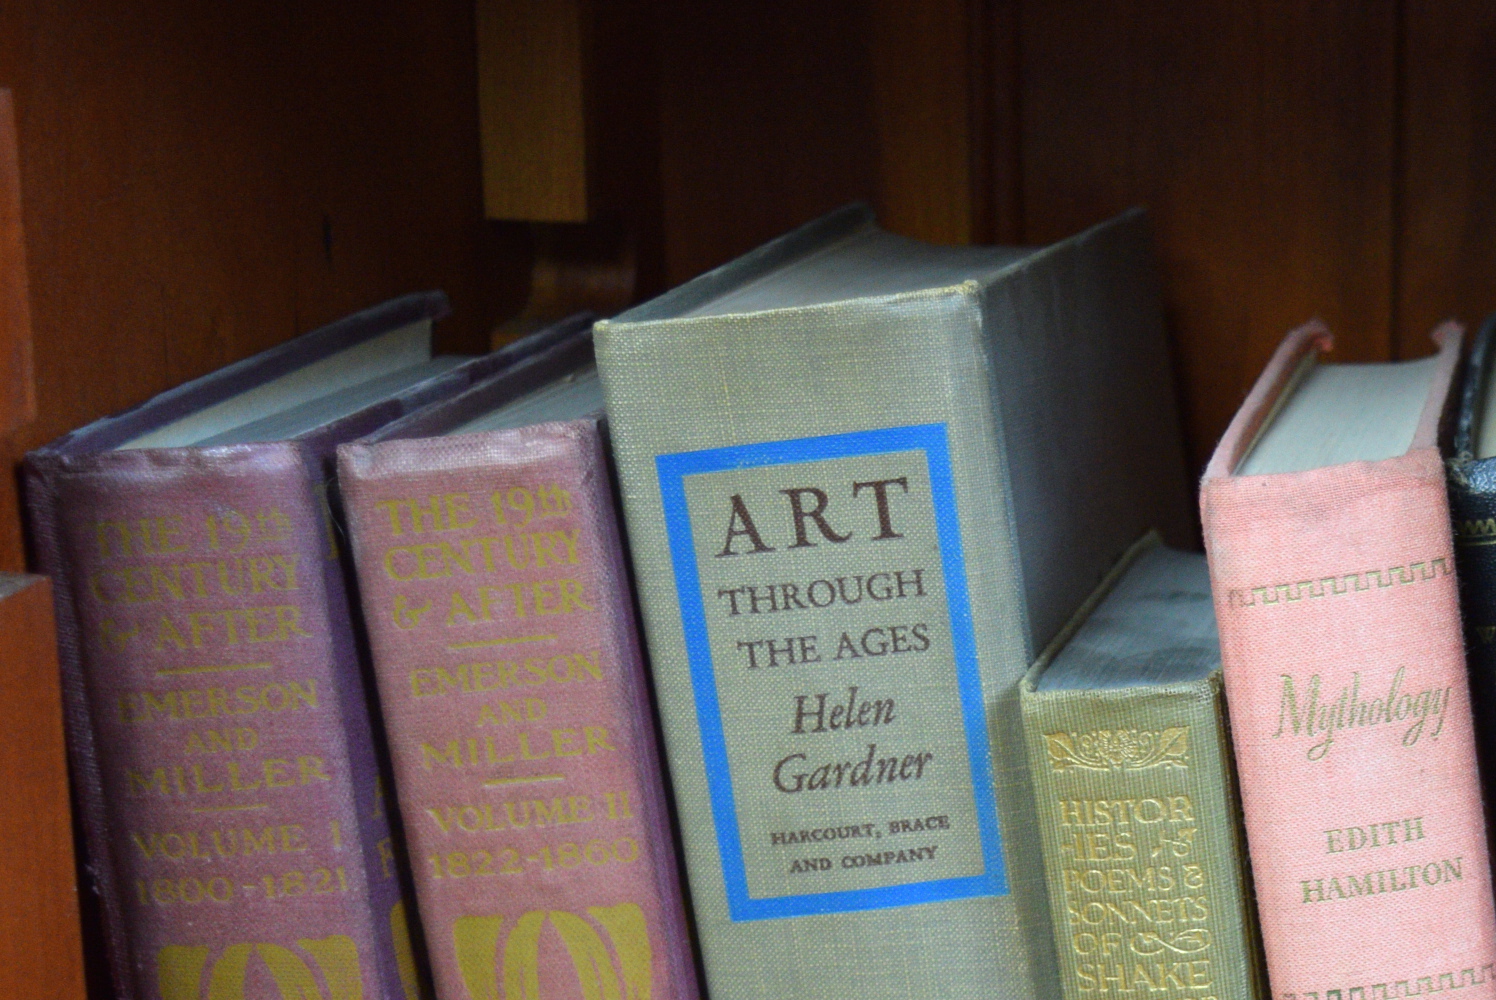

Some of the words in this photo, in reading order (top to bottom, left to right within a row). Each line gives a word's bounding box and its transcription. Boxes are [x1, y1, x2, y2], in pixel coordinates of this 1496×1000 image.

[86, 514, 189, 557] THE
[205, 505, 293, 554] 19th
[374, 491, 479, 536] THE
[490, 482, 573, 528] 19th
[714, 476, 910, 560] ART
[383, 528, 582, 581] CENTURY
[91, 554, 301, 603] CENTURY
[717, 568, 928, 617] THROUGH
[392, 594, 433, 629] &
[446, 578, 595, 626] AFTER
[99, 616, 141, 651] &
[156, 604, 313, 651] AFTER
[737, 634, 822, 670] THE
[833, 623, 932, 661] AGES
[409, 651, 604, 698] EMERSON
[117, 678, 320, 724] EMERSON
[477, 697, 549, 727] AND
[790, 686, 896, 735] Helen
[1273, 666, 1454, 761] Mythology
[185, 726, 260, 754] AND
[420, 726, 616, 769] MILLER
[126, 754, 332, 796] MILLER
[772, 744, 934, 795] Gardner
[426, 795, 595, 834] VOLUME
[604, 790, 635, 821] II
[771, 824, 882, 847] HARCOURT,
[889, 815, 950, 836] BRACE
[1059, 796, 1196, 827] HISTOR
[131, 823, 308, 860] VOLUME
[329, 819, 344, 851] I
[428, 836, 639, 880] 1822-1860
[1324, 818, 1426, 855] EDITH
[789, 855, 833, 874] AND
[841, 845, 939, 872] COMPANY
[1063, 866, 1176, 893] POEMS
[1301, 857, 1463, 905] HAMILTON
[1068, 896, 1209, 925] SONNETS
[1073, 932, 1123, 955] OF
[1077, 961, 1214, 992] SHAKE
